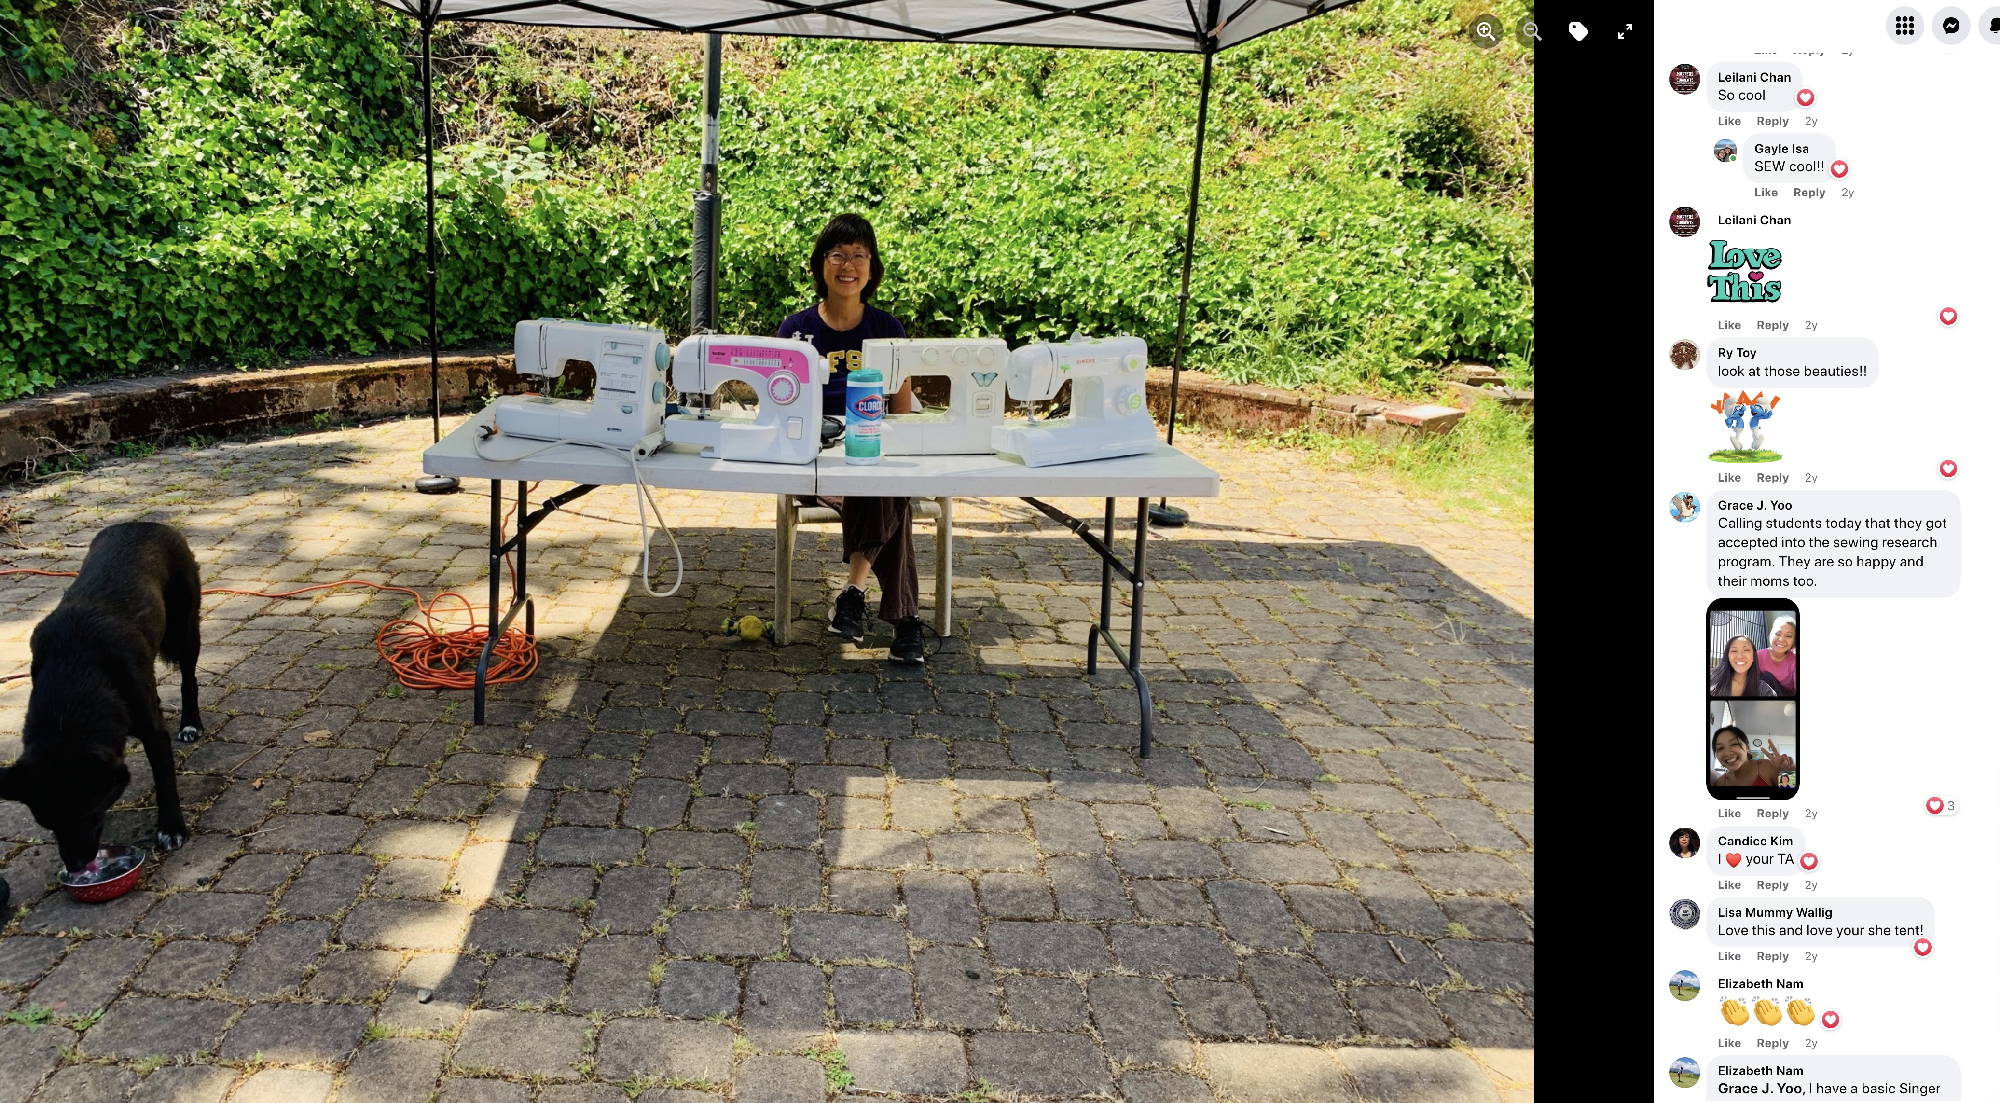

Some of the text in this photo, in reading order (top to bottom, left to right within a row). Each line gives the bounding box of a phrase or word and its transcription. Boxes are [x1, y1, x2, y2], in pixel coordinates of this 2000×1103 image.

[1719, 72, 1791, 82] Leilani Chan
[1719, 89, 1765, 100] So cool
[1719, 116, 1817, 127] Like Reply 2y
[1755, 144, 1808, 155] Gayle Isa
[1755, 161, 1824, 172] SEW cool!!
[1755, 188, 1854, 199] Like Reply 2y
[1719, 215, 1791, 225] Leilani Chan
[1708, 240, 1782, 270] Love
[1707, 271, 1782, 303] This
[1719, 320, 1817, 331] Like Reply 2y
[1719, 348, 1756, 359] Ry Toy
[820, 350, 862, 373] FS
[1719, 366, 1866, 376] look at those beauties!!
[859, 401, 882, 411] CLORO
[1719, 473, 1817, 484] Like Reply 2y
[1718, 500, 1792, 510] Grace J. Yoo
[1719, 517, 1946, 531] Calling students today that they got
[1718, 537, 1937, 550] accepted into the sewing research
[1719, 559, 1774, 569] program.
[1779, 556, 1810, 569] They
[1815, 559, 1834, 567] are
[1857, 556, 1896, 569] happy
[1900, 556, 1923, 566] and
[1718, 576, 1816, 586] their moms too.
[1948, 801, 1954, 810] 3
[1719, 809, 1817, 820] Like Reply 2y
[1718, 836, 1793, 846] Candice Kim
[1746, 856, 1774, 867] your
[1778, 854, 1794, 864] TA
[1719, 880, 1817, 891] Like Reply 2y
[1719, 908, 1832, 919] Lisa Mummy Wallig
[1719, 925, 1924, 938] Love this and love your she tent!
[1719, 952, 1817, 963] Like Reply 2y
[1719, 979, 1803, 989] Elizabeth Nam
[1719, 1038, 1817, 1049] Like Reply 2y
[1719, 1066, 1803, 1076] Elizabeth Nam
[1718, 1083, 1758, 1094] Grace
[1762, 1083, 1773, 1094] J.
[1777, 1083, 1805, 1096] Yoo,
[1817, 1083, 1847, 1093] have
[1850, 1085, 1858, 1094] a
[1863, 1083, 1895, 1093] basic
[1900, 1083, 1940, 1096] Singer
